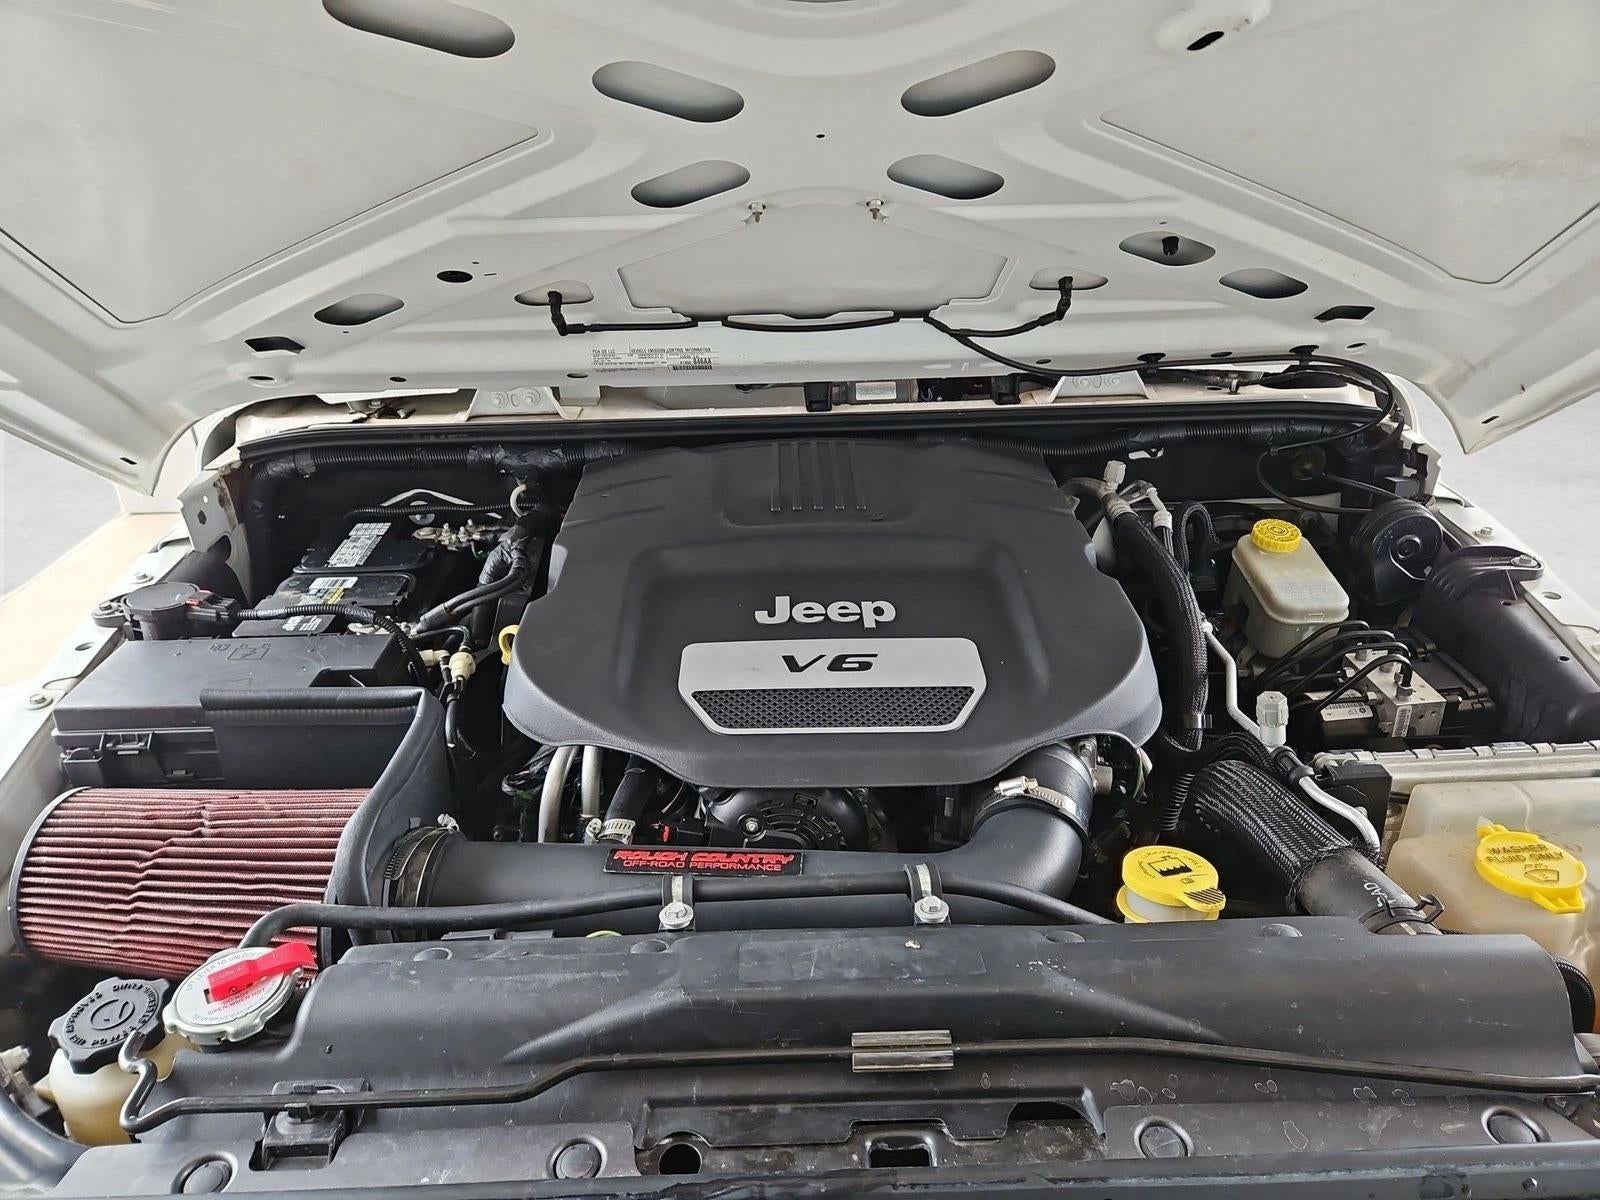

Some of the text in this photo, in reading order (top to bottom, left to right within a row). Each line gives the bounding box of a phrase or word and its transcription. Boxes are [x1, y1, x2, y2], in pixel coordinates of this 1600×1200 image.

[754, 595, 896, 630] Jeep
[781, 653, 878, 673] V6
[1488, 843, 1549, 855] WASHER
[613, 850, 795, 864] ROUGH COUNTRY
[1486, 851, 1564, 864] FLUID ONLY
[623, 859, 782, 871] OFF-ROAD PERFORMANCE
[207, 987, 267, 1015] OPEN WHEN HOT
[232, 991, 250, 1002] NOT
[91, 1025, 137, 1047] POWER
